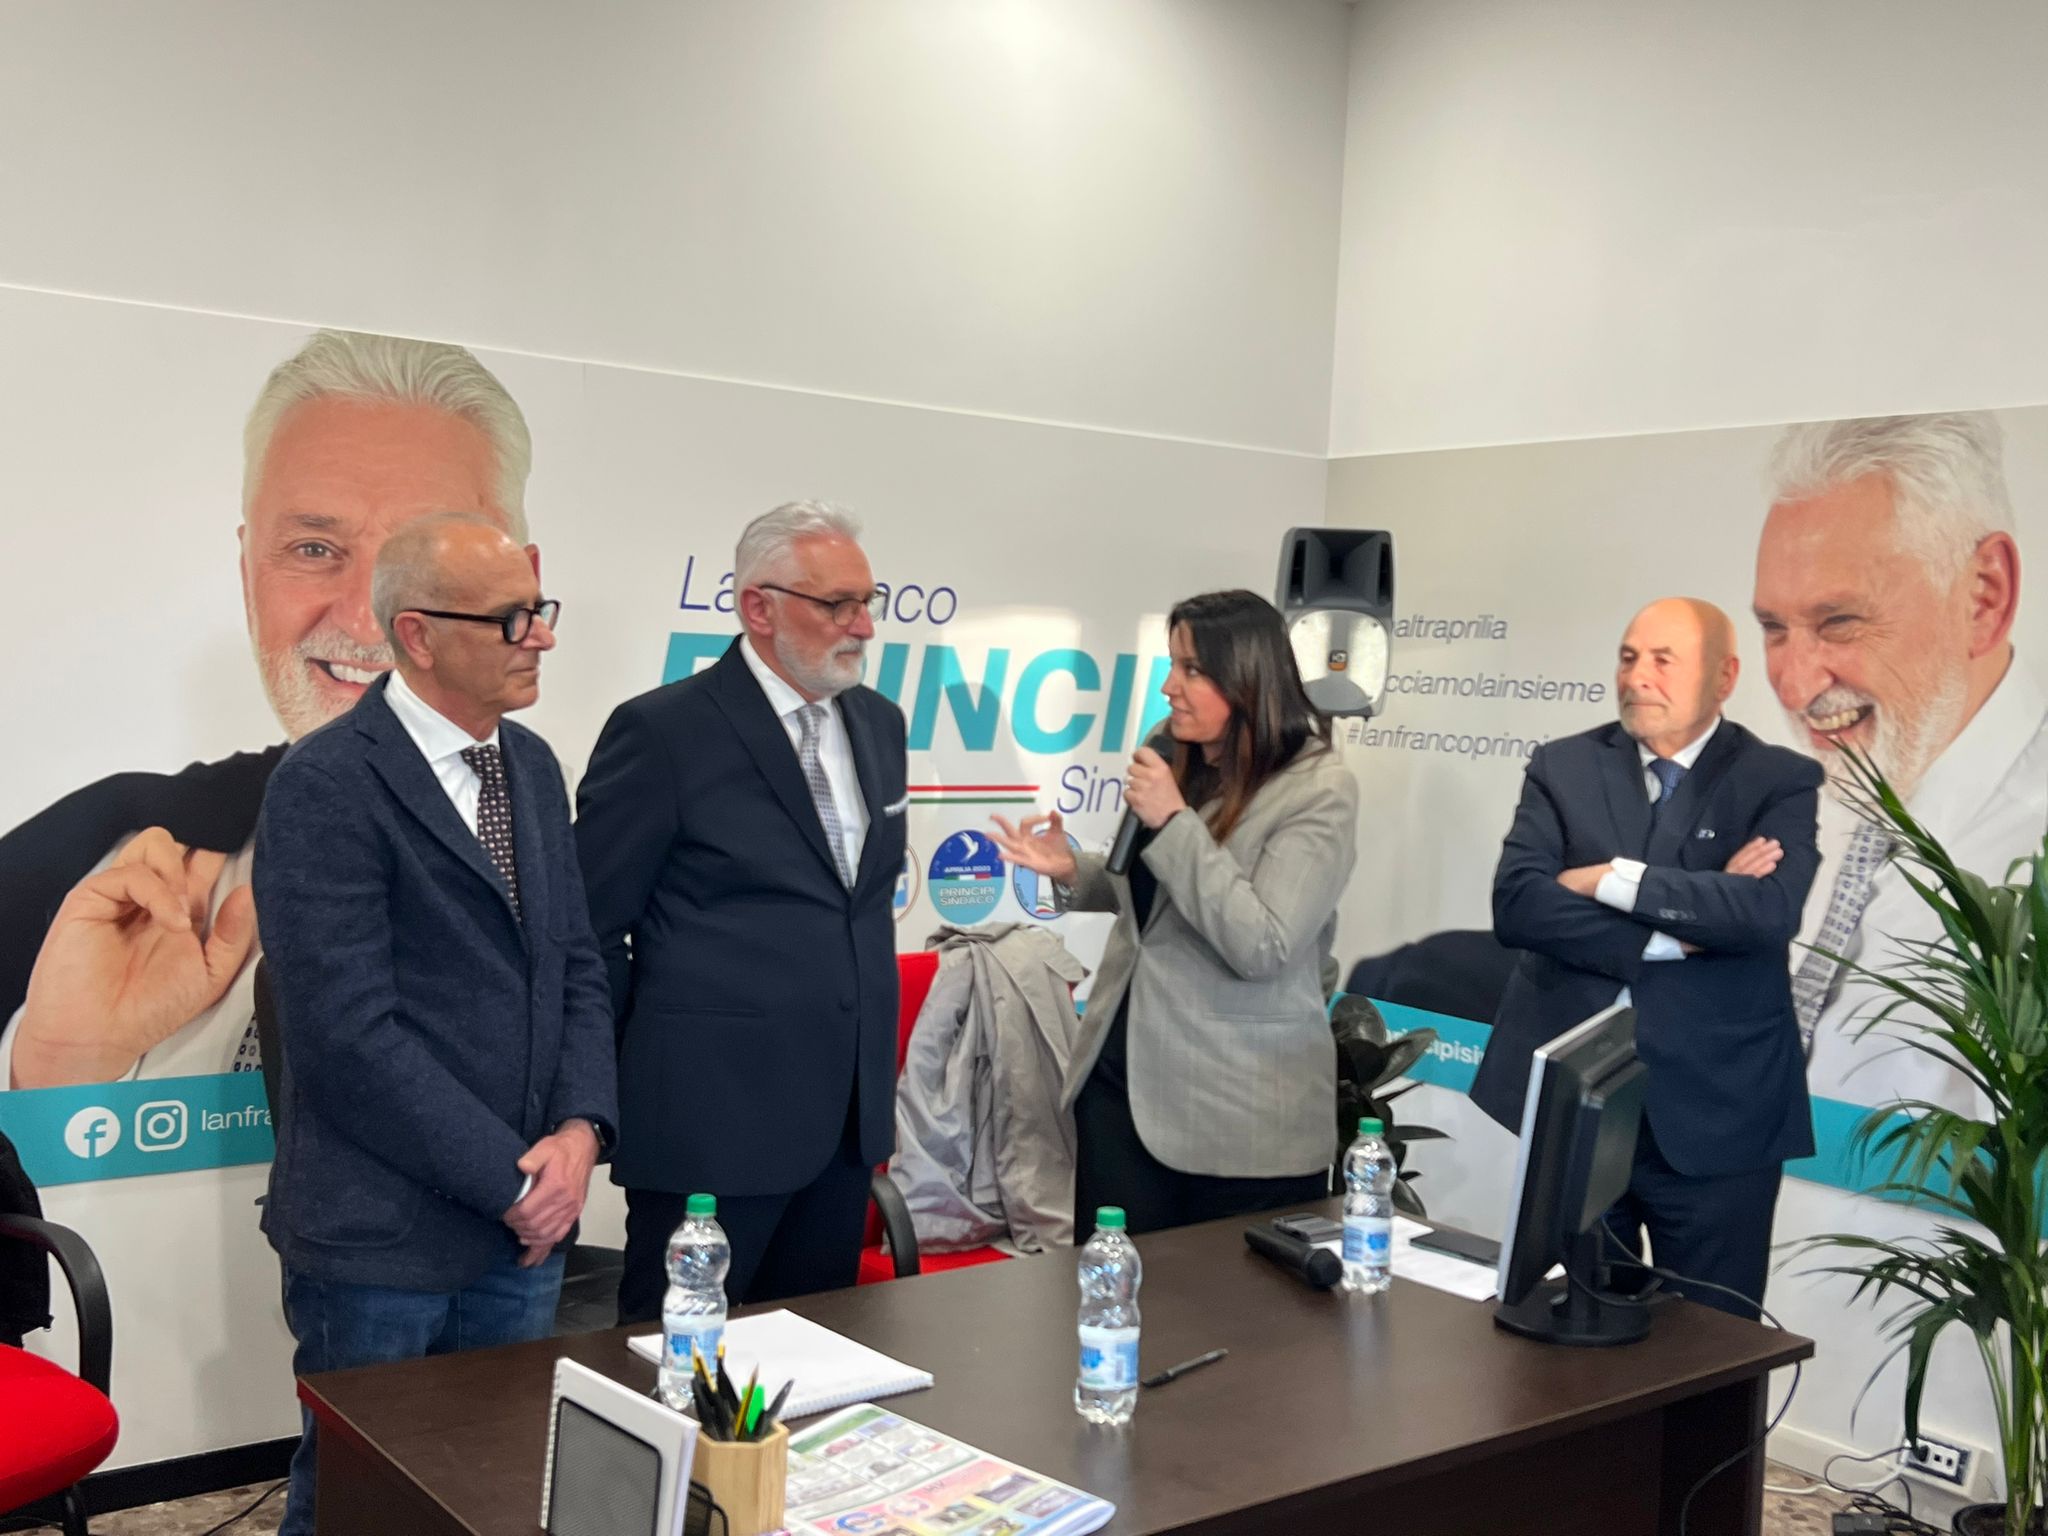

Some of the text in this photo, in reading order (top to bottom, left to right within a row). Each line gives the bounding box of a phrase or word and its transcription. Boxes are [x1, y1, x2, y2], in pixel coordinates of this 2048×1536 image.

[680, 555, 958, 626] Lanco
[1384, 669, 1607, 703] cciamolainsieme
[1056, 764, 1122, 814] Sin
[940, 886, 996, 897] PRINCIPI
[940, 895, 994, 905] SINDACO
